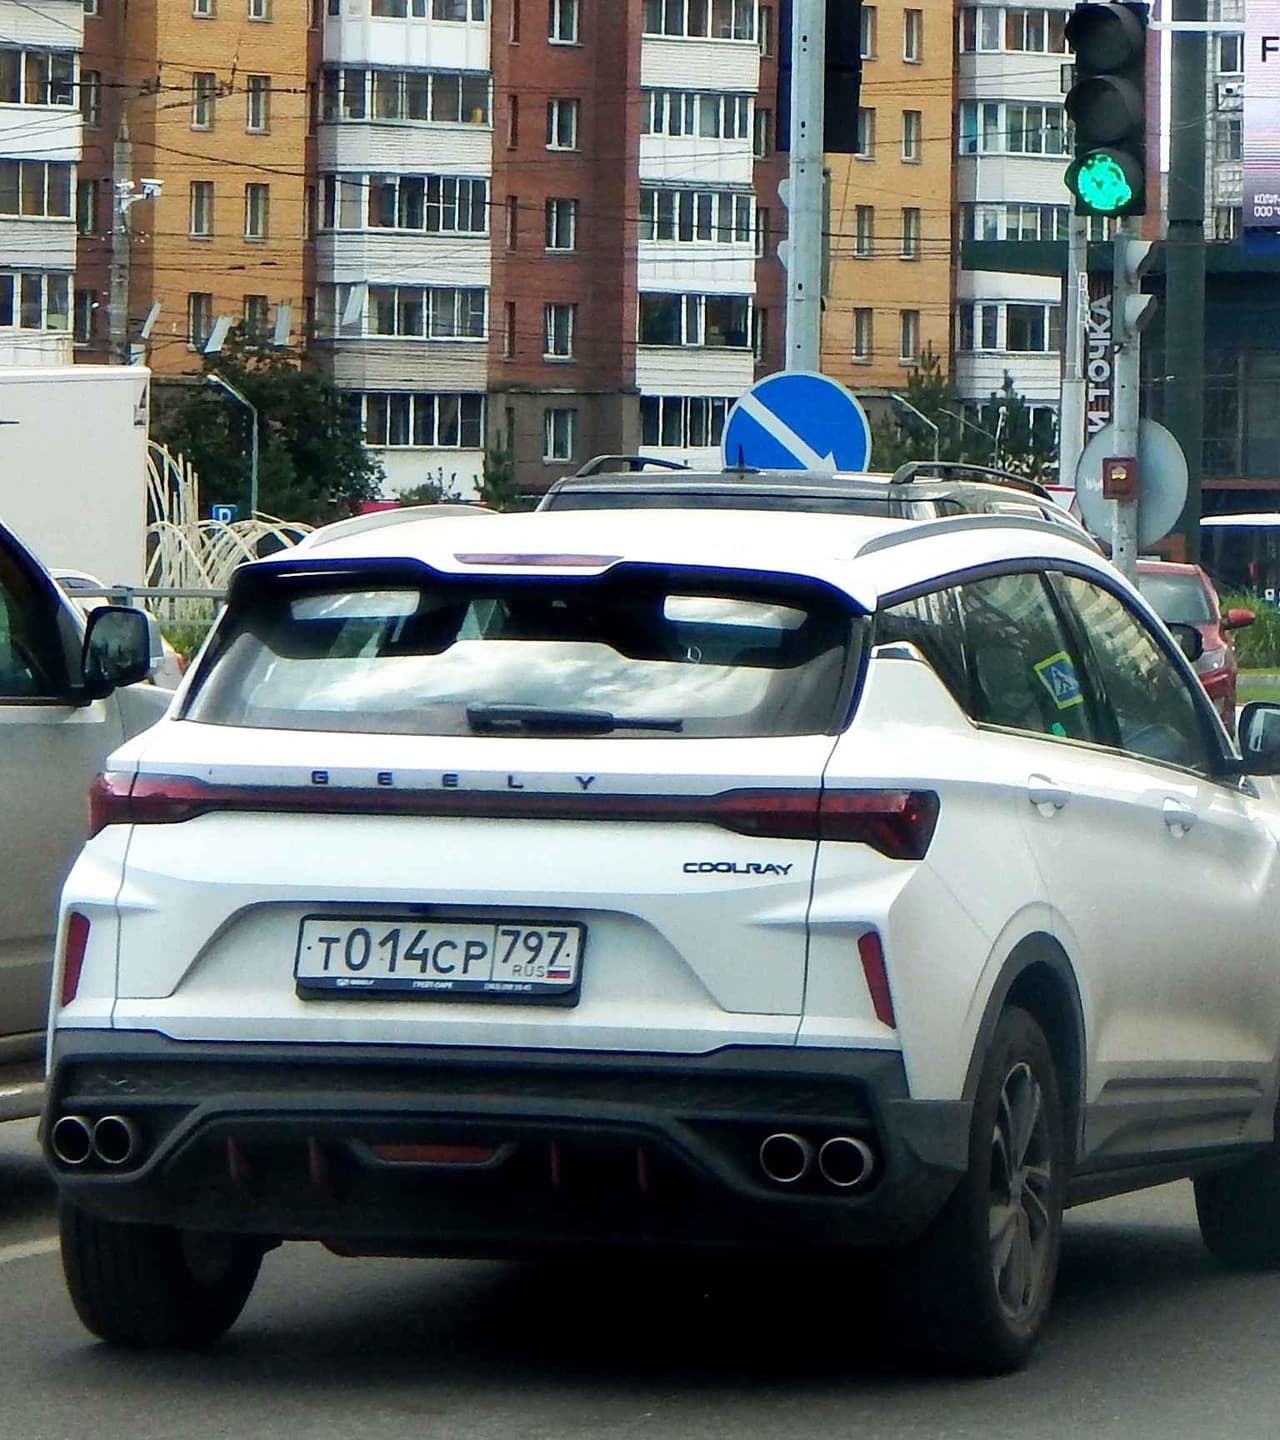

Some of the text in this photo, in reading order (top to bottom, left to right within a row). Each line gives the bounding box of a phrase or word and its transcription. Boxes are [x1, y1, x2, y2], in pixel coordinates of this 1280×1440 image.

[1254, 205, 1274, 217] ООО
[1087, 294, 1113, 402] ТОЧКА
[310, 769, 598, 792] GEELY
[682, 861, 794, 877] COOLRAY
[500, 928, 568, 967] 797
[511, 964, 545, 978] RUS
